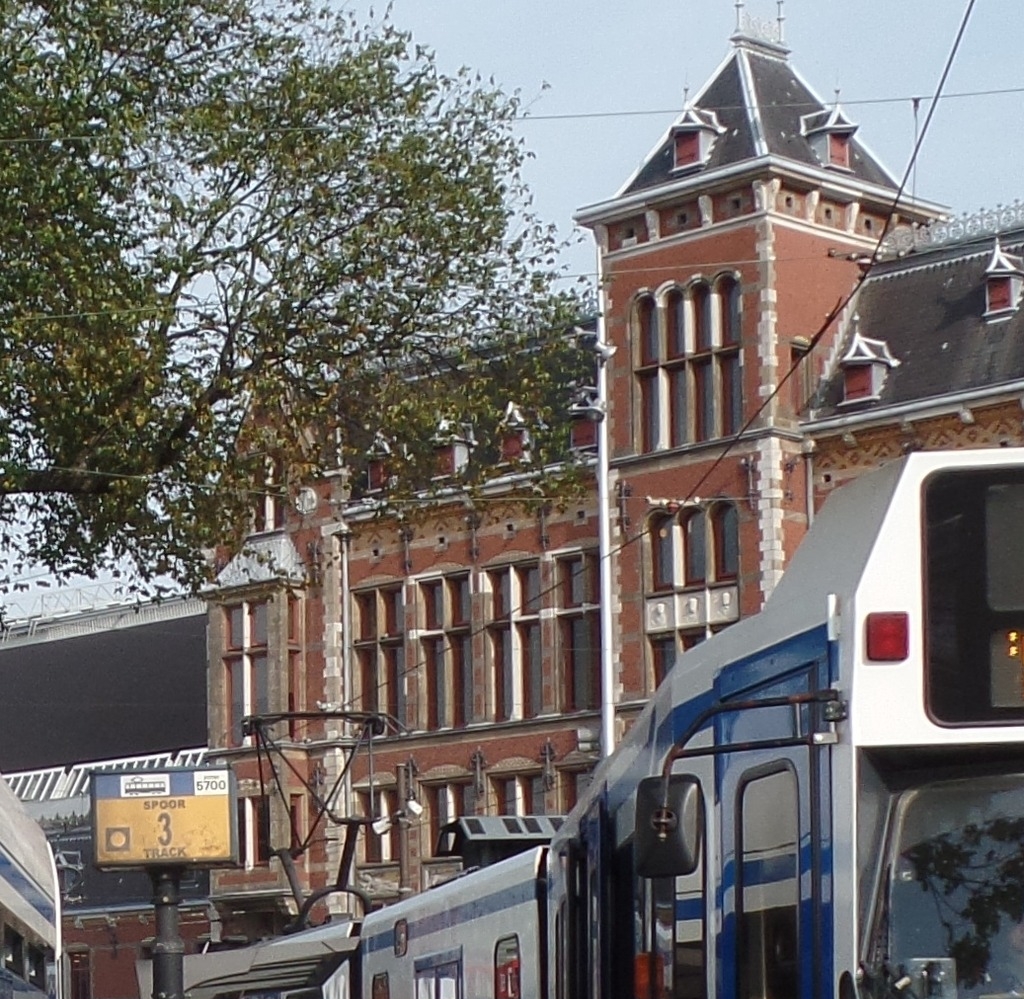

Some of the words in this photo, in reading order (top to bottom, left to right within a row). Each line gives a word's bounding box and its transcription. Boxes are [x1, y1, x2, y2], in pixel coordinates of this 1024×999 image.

[196, 780, 226, 791] 5700
[143, 800, 186, 810] SPOOR
[157, 812, 173, 846] 3
[143, 847, 187, 858] TRACK
